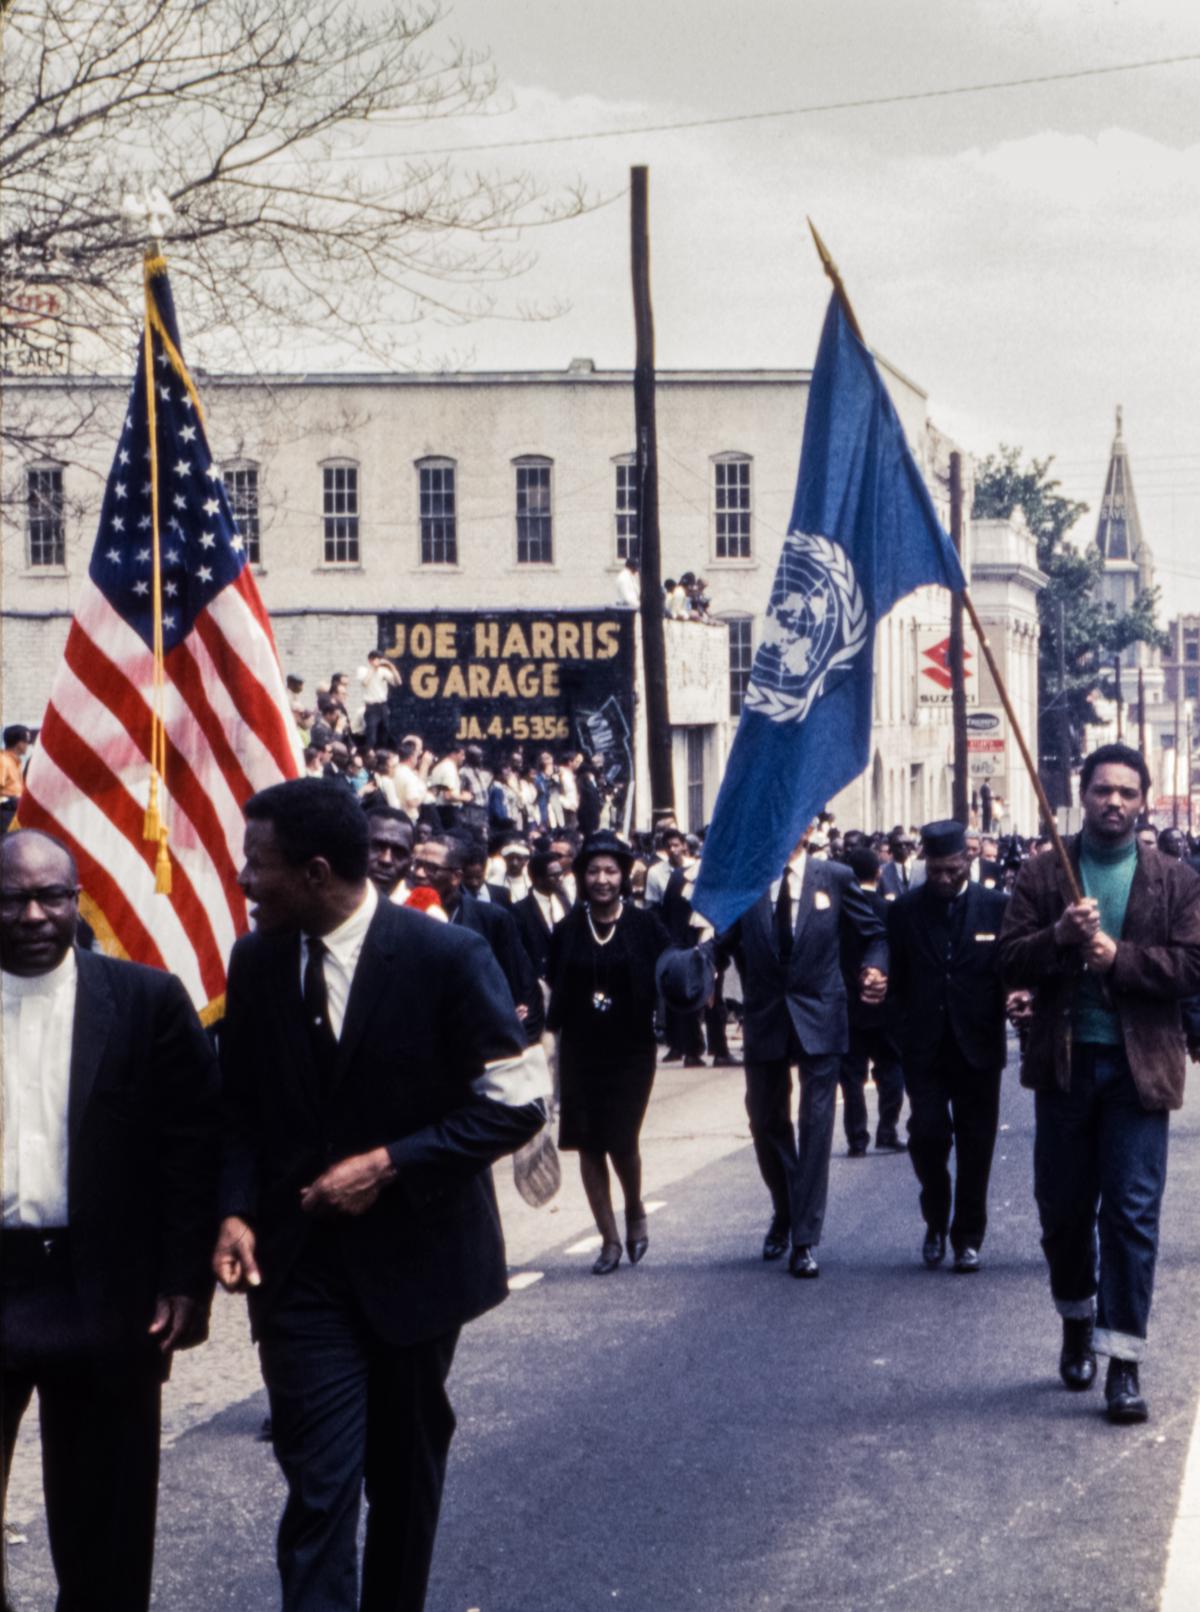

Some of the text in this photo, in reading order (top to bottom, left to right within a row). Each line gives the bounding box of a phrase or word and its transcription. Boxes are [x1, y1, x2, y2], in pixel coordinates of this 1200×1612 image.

[384, 621, 621, 660] JOE HARRIS
[410, 663, 560, 699] GARAGE
[920, 694, 976, 703] SUZI
